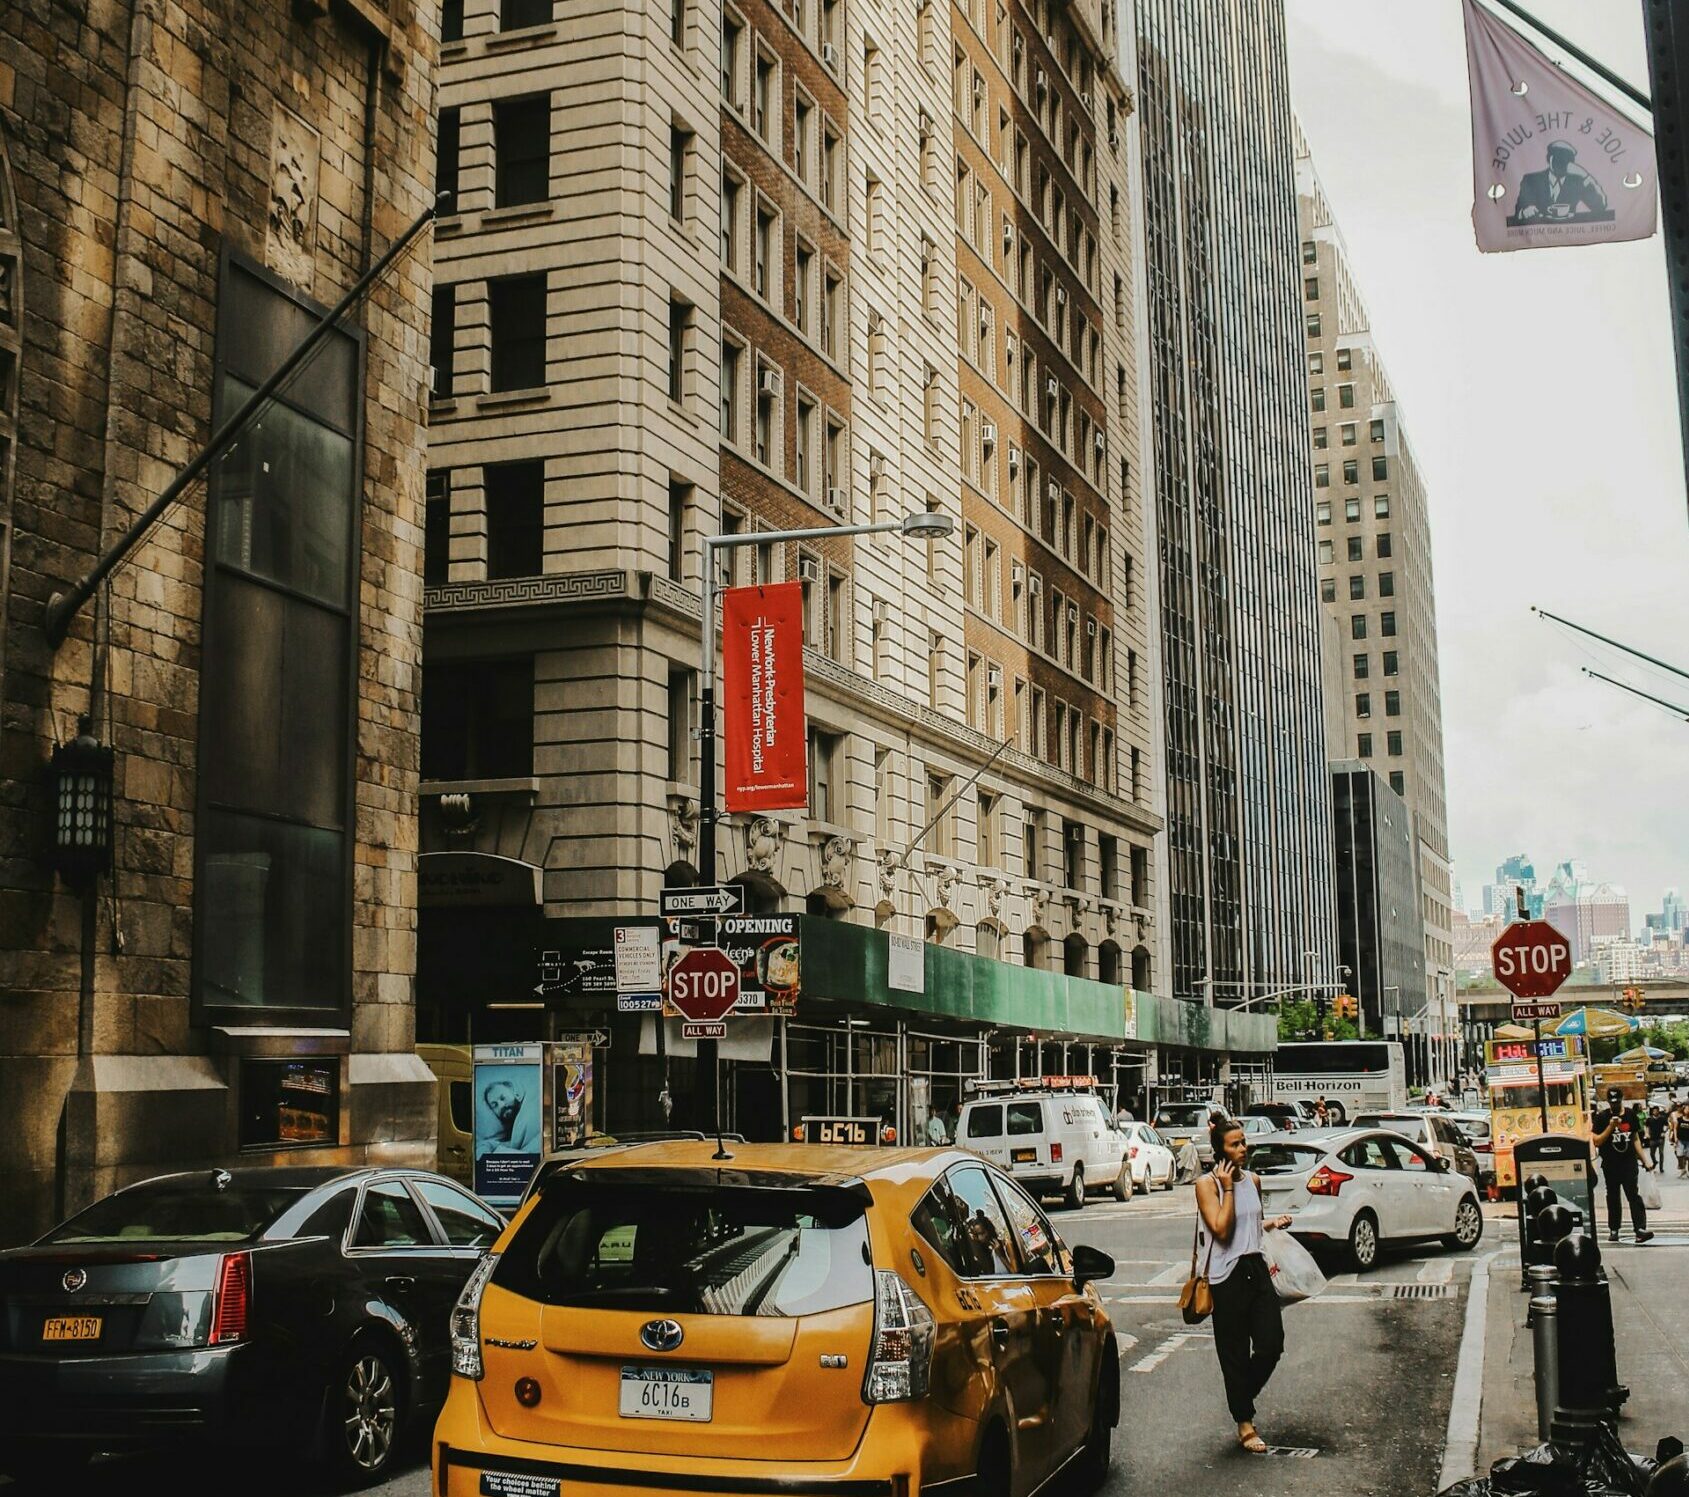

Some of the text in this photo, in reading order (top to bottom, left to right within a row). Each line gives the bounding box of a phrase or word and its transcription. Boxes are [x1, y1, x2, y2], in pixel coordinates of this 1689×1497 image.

[751, 630, 764, 774] Lower Manhattan Hospital
[672, 895, 730, 908] ONE WAY
[725, 918, 793, 934] OPENING
[617, 930, 625, 942] 3
[1499, 944, 1566, 976] STOP
[674, 971, 736, 998] STOP
[1516, 1004, 1556, 1017] ALL WAY
[686, 1026, 722, 1035] ALL WAY
[492, 1047, 524, 1057] TITAN
[1276, 1080, 1361, 1091] Bell Horizon
[1612, 1132, 1632, 1142] NY
[643, 1371, 690, 1382] NEW YORK
[502, 1478, 529, 1487] choices
[531, 1482, 556, 1490] behind
[503, 1485, 524, 1493] wheel
[525, 1488, 550, 1496] matter
